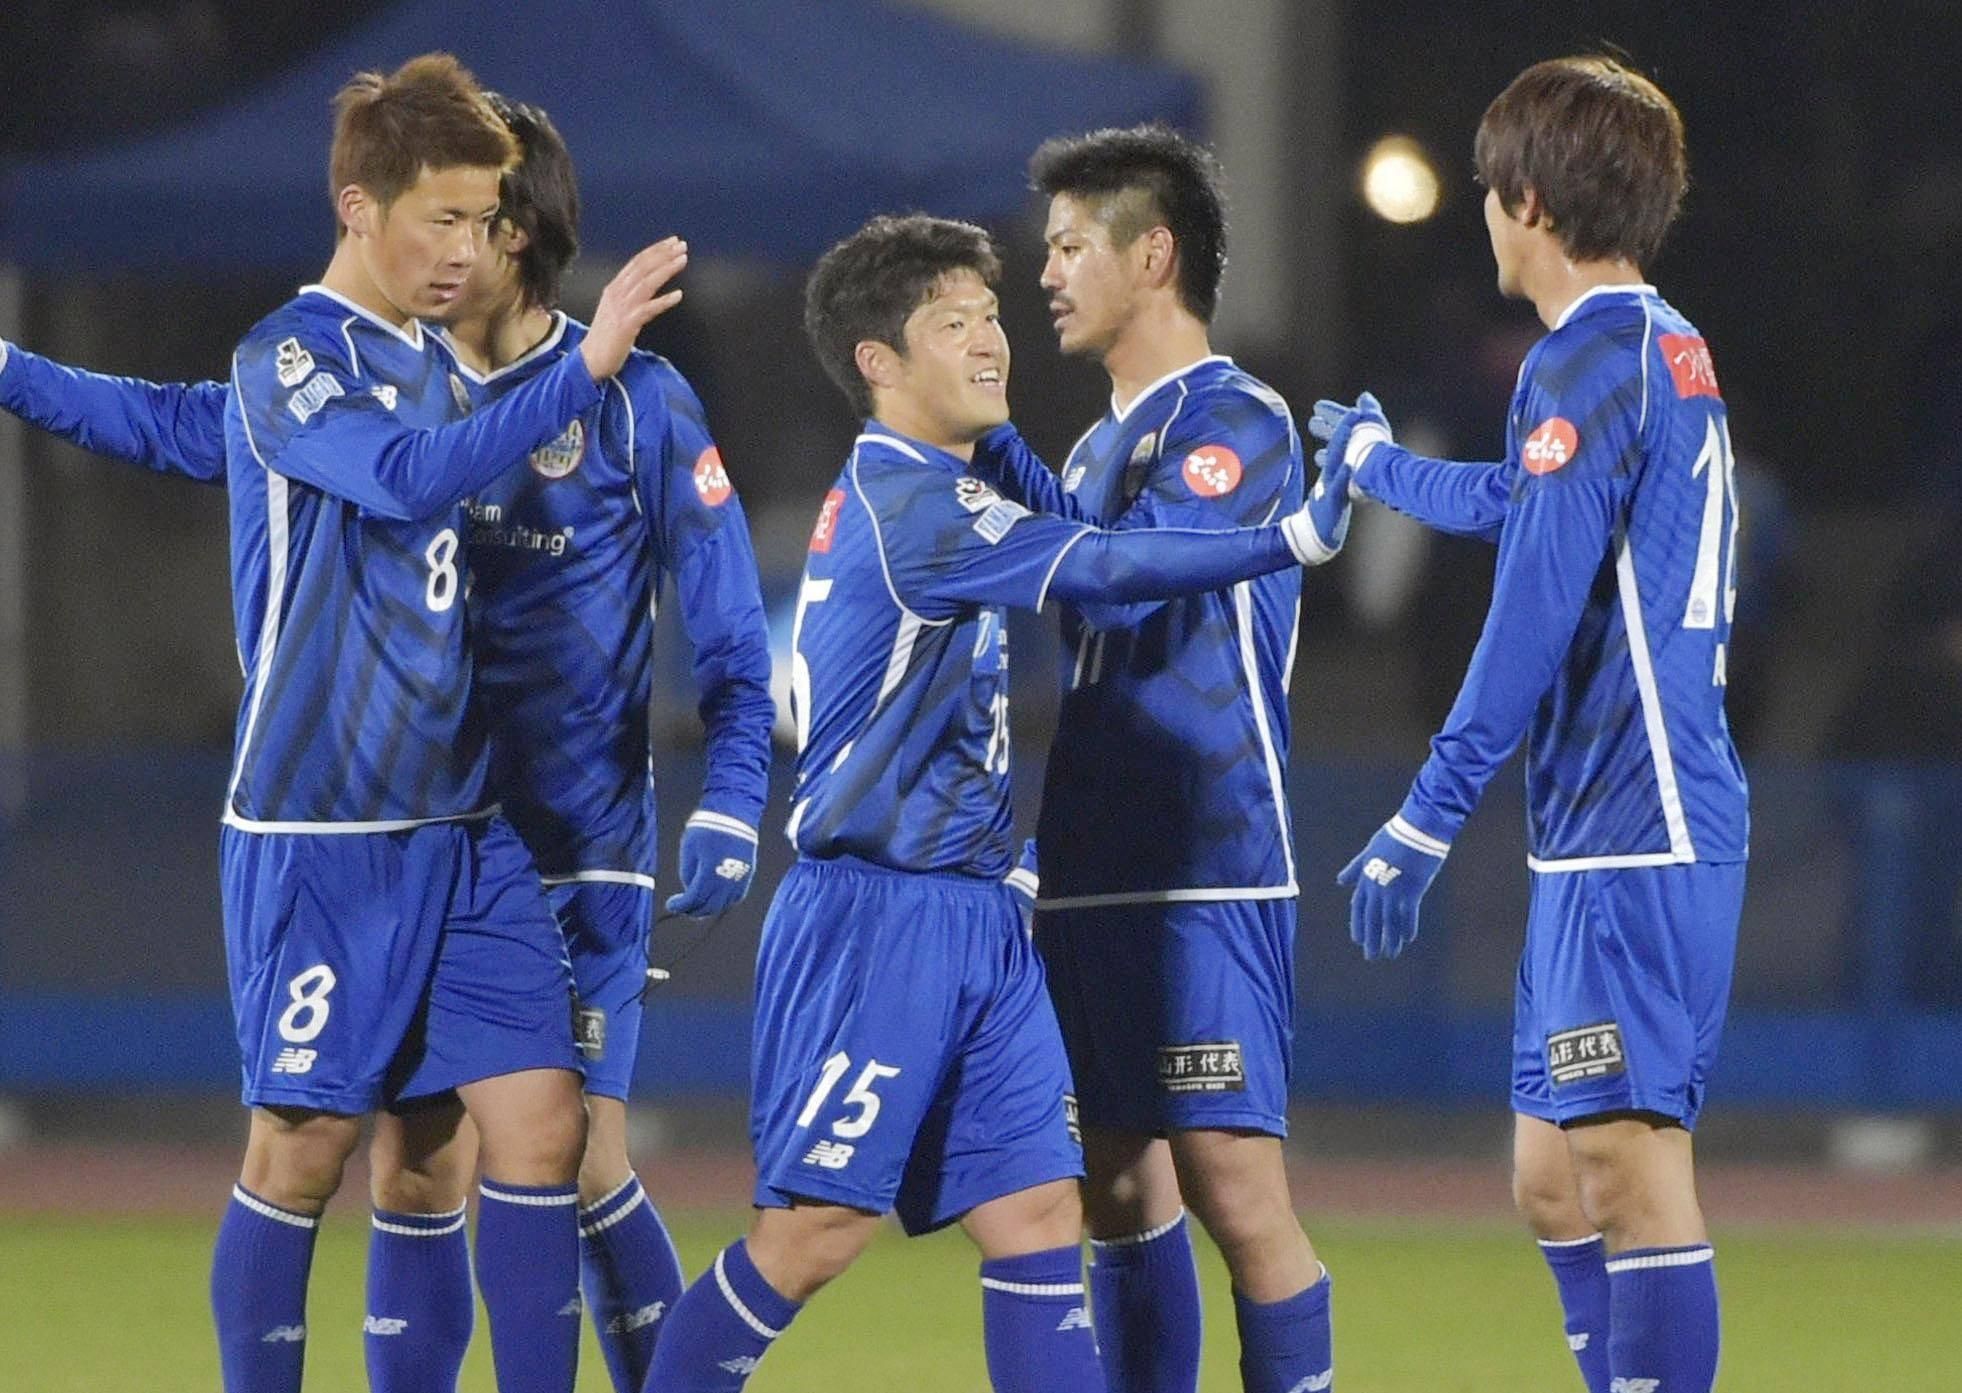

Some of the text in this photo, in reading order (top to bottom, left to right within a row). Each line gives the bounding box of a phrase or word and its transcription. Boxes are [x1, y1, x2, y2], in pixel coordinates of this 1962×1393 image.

[424, 528, 460, 612] 8
[278, 963, 337, 1043] 8
[796, 1050, 902, 1138] 15
